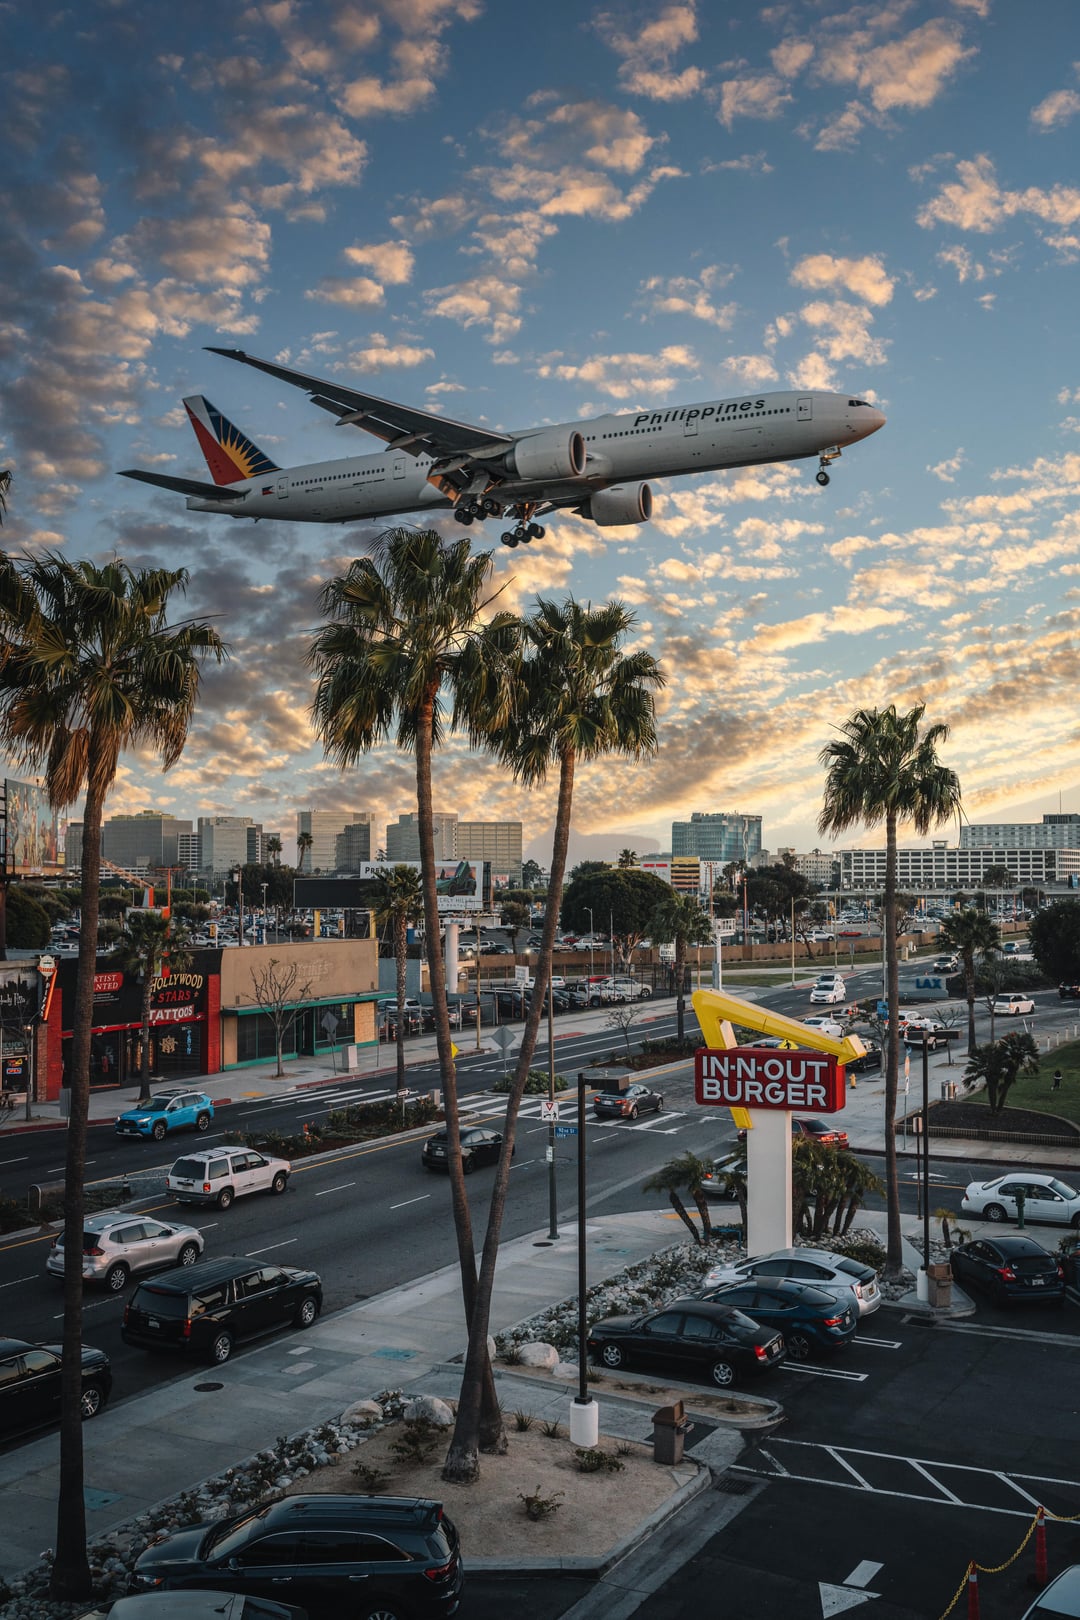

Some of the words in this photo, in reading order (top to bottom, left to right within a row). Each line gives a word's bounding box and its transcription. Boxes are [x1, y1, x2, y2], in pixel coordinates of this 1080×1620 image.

[633, 399, 765, 427] Philippines
[93, 974, 117, 983] RTIST
[150, 973, 203, 993] HOLLYWOOD
[915, 978, 942, 989] LAX
[95, 982, 119, 991] NTED
[157, 990, 191, 1003] STARS
[149, 1005, 193, 1020] TATTOOS
[702, 1055, 829, 1083] IN-N-OUT
[702, 1078, 828, 1107] BURGER
